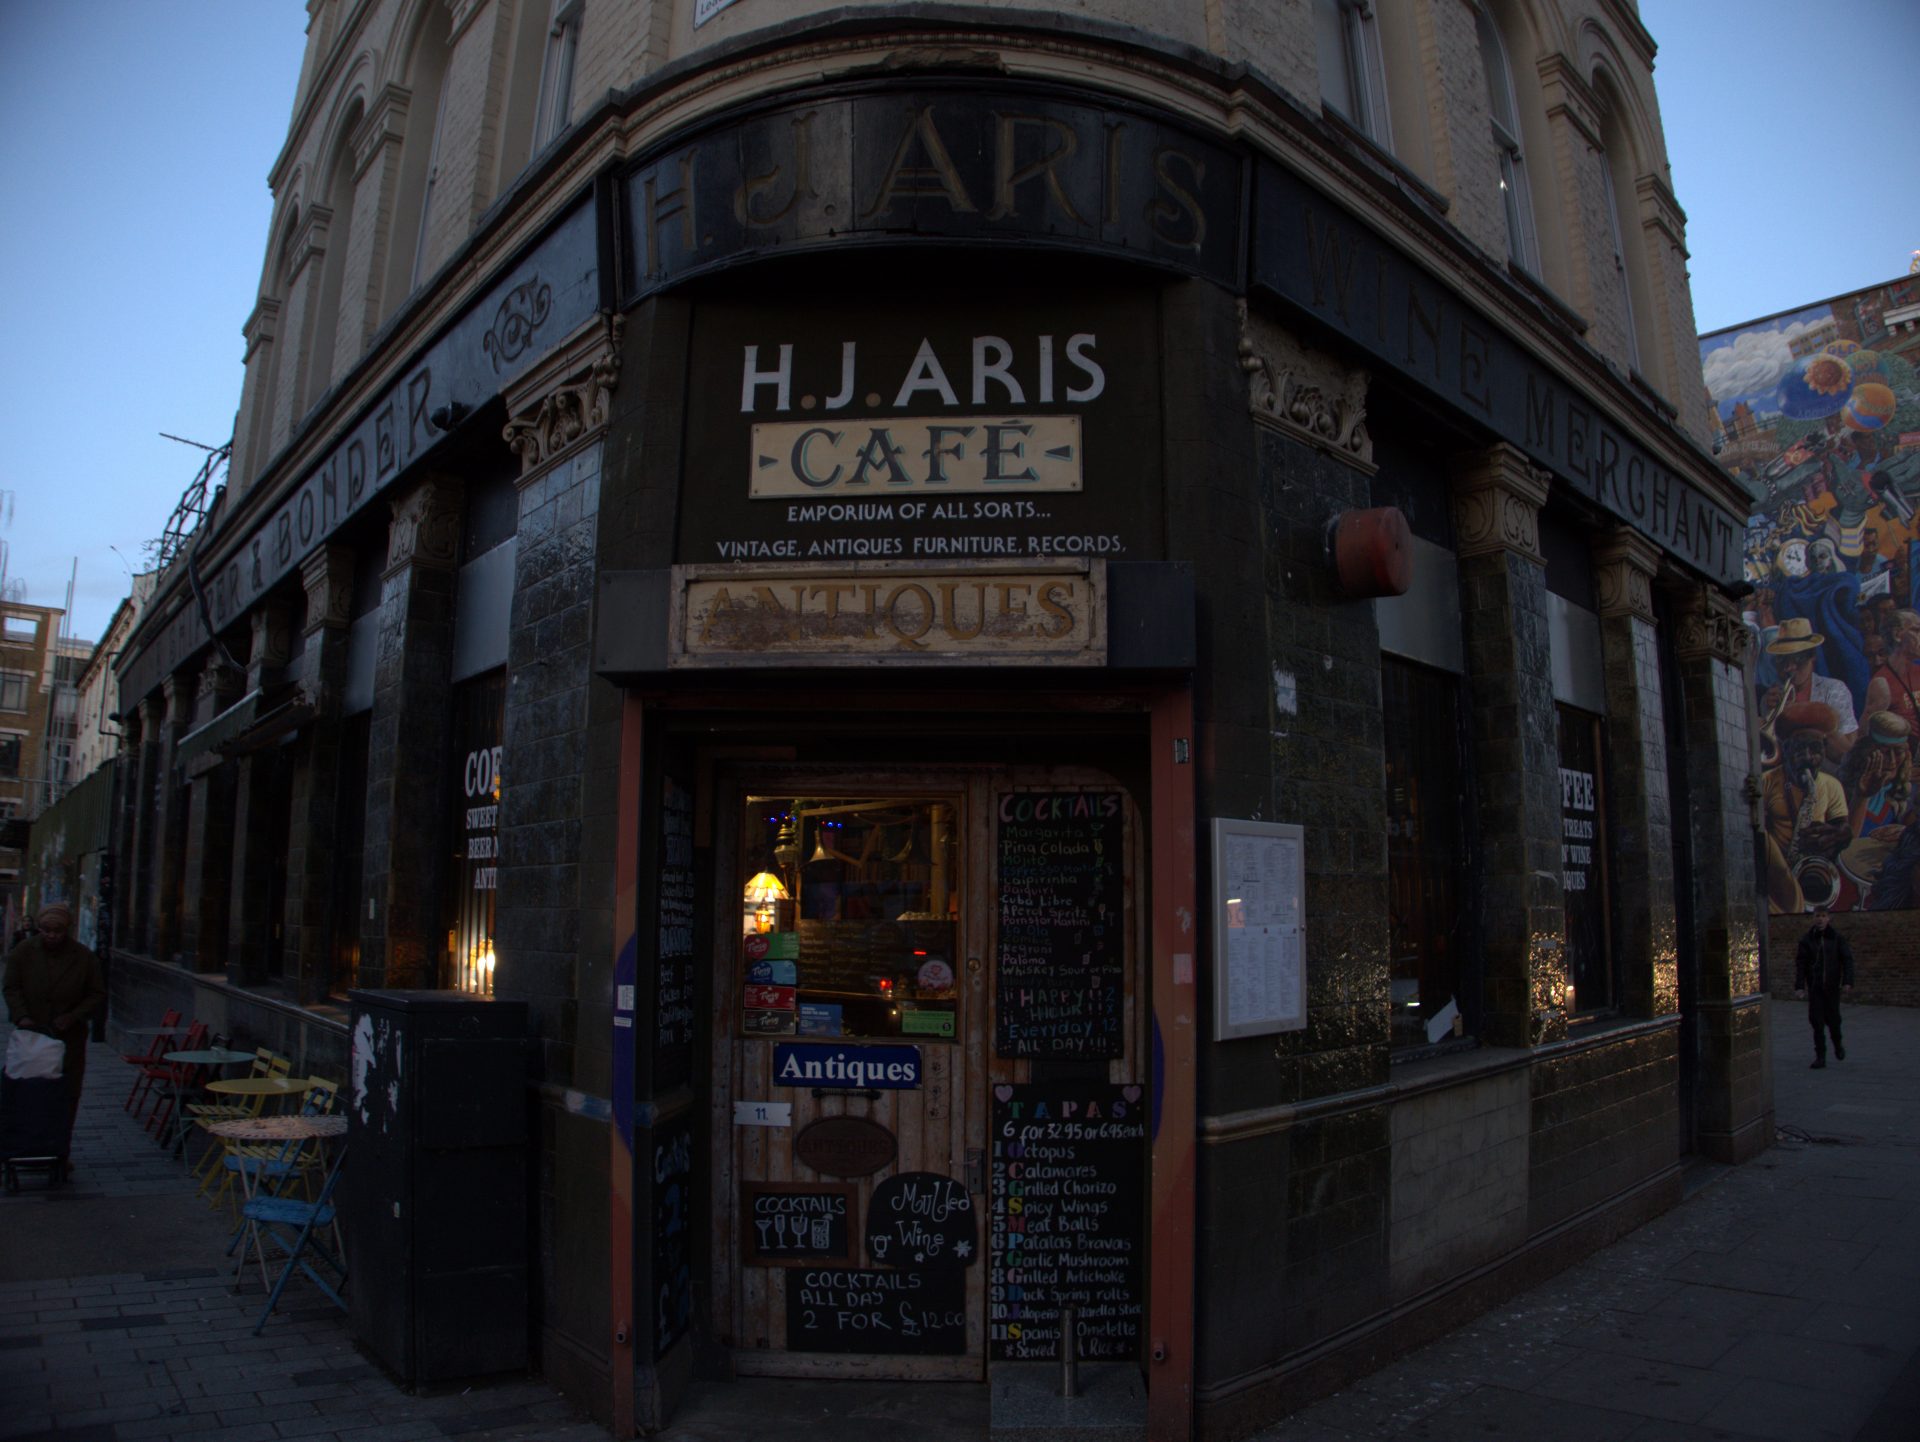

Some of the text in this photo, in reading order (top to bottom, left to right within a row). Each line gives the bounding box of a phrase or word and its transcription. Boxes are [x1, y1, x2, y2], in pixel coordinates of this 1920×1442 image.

[1305, 208, 1732, 577] WINE MERCHANT
[791, 420, 1038, 487] CAFÉ
[278, 366, 440, 568] BONDER
[787, 504, 894, 523] EMPORIUM
[900, 502, 927, 520] OF
[933, 501, 968, 519] ALL
[808, 537, 903, 557] ANTIQUES
[914, 535, 1023, 555] FURNITURE,
[702, 580, 1075, 648] ANTIQUES
[1000, 794, 1119, 822] COCKTAILS
[1563, 818, 1592, 839] TREATS
[468, 836, 491, 859] BEER
[1040, 841, 1089, 855] Colada
[1570, 844, 1591, 864] WINE
[474, 867, 497, 888] ANTI
[1562, 870, 1585, 891] IQUES
[780, 1053, 916, 1086] Antiques
[1003, 1121, 1016, 1137] 6
[1020, 1125, 1045, 1148] for
[1007, 1141, 1076, 1163] Octopus
[992, 1161, 1097, 1179] 2 Calamares
[992, 1180, 1117, 1196] 3 Grilled Chorizo
[755, 1196, 845, 1215] COCKTAILS
[991, 1196, 1108, 1220] 4 Spicy Wings
[992, 1215, 1100, 1233] 5 Meat Balls
[991, 1233, 1005, 1249] 6
[1077, 1232, 1131, 1250] Bravas
[991, 1251, 1004, 1267] 7
[1007, 1250, 1053, 1267] Garlic
[805, 1272, 921, 1290] COCKTAILS
[991, 1268, 1005, 1284] 8
[1007, 1267, 1058, 1284] Grilled
[801, 1291, 883, 1306] ALL DAY
[991, 1285, 1005, 1301] 9
[1050, 1286, 1090, 1306] Spring
[802, 1311, 819, 1329] 2
[837, 1312, 892, 1330] FOR
